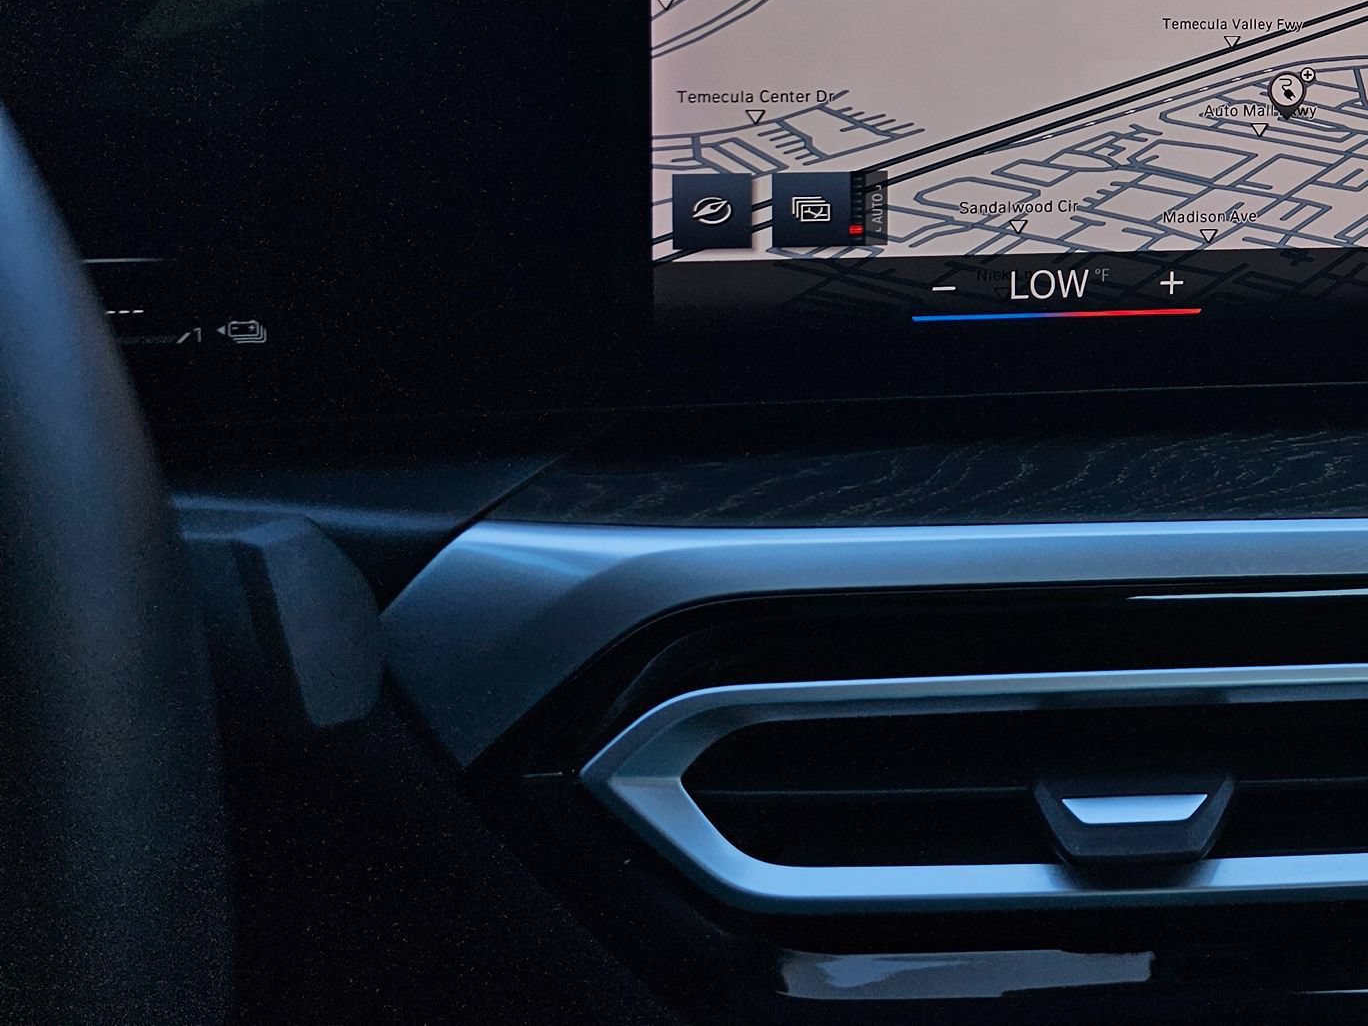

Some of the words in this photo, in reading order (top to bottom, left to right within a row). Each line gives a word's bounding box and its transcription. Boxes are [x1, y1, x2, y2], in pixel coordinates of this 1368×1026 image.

[1163, 18, 1228, 31] Temecula
[1232, 18, 1273, 33] Valley
[1277, 18, 1303, 33] Fwy
[677, 90, 755, 104] Temecula
[759, 89, 808, 104] Center
[811, 89, 835, 104] Dr
[1204, 105, 1239, 117] Auto
[1243, 104, 1275, 116] Mall
[871, 193, 884, 224] AUTO
[959, 200, 1054, 215] Sandalwood
[1057, 199, 1079, 213] Cir
[1163, 210, 1225, 224] Madison
[1229, 210, 1258, 224] Ave
[1010, 268, 1089, 300] LOW
